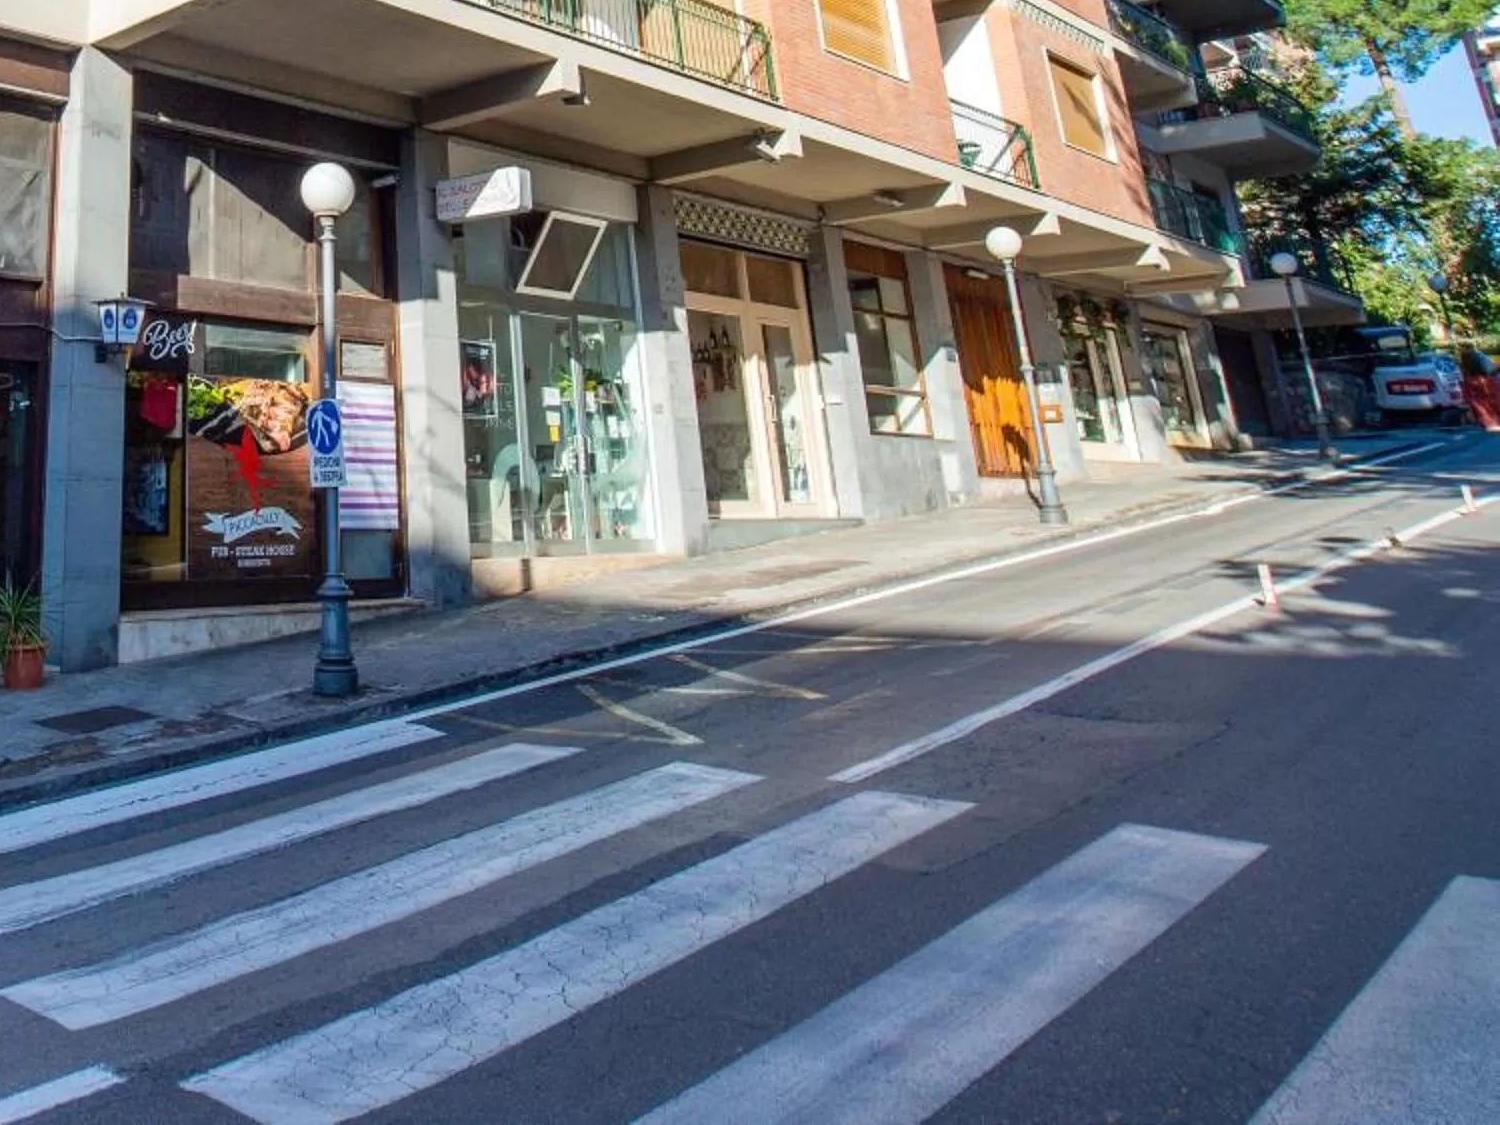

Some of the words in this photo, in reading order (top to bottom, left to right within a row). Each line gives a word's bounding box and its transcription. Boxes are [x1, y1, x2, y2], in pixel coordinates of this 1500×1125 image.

[228, 511, 282, 533] PICCADILLY
[211, 546, 229, 558] PUB
[235, 545, 264, 557] STEAK
[266, 544, 295, 556] HOUSE
